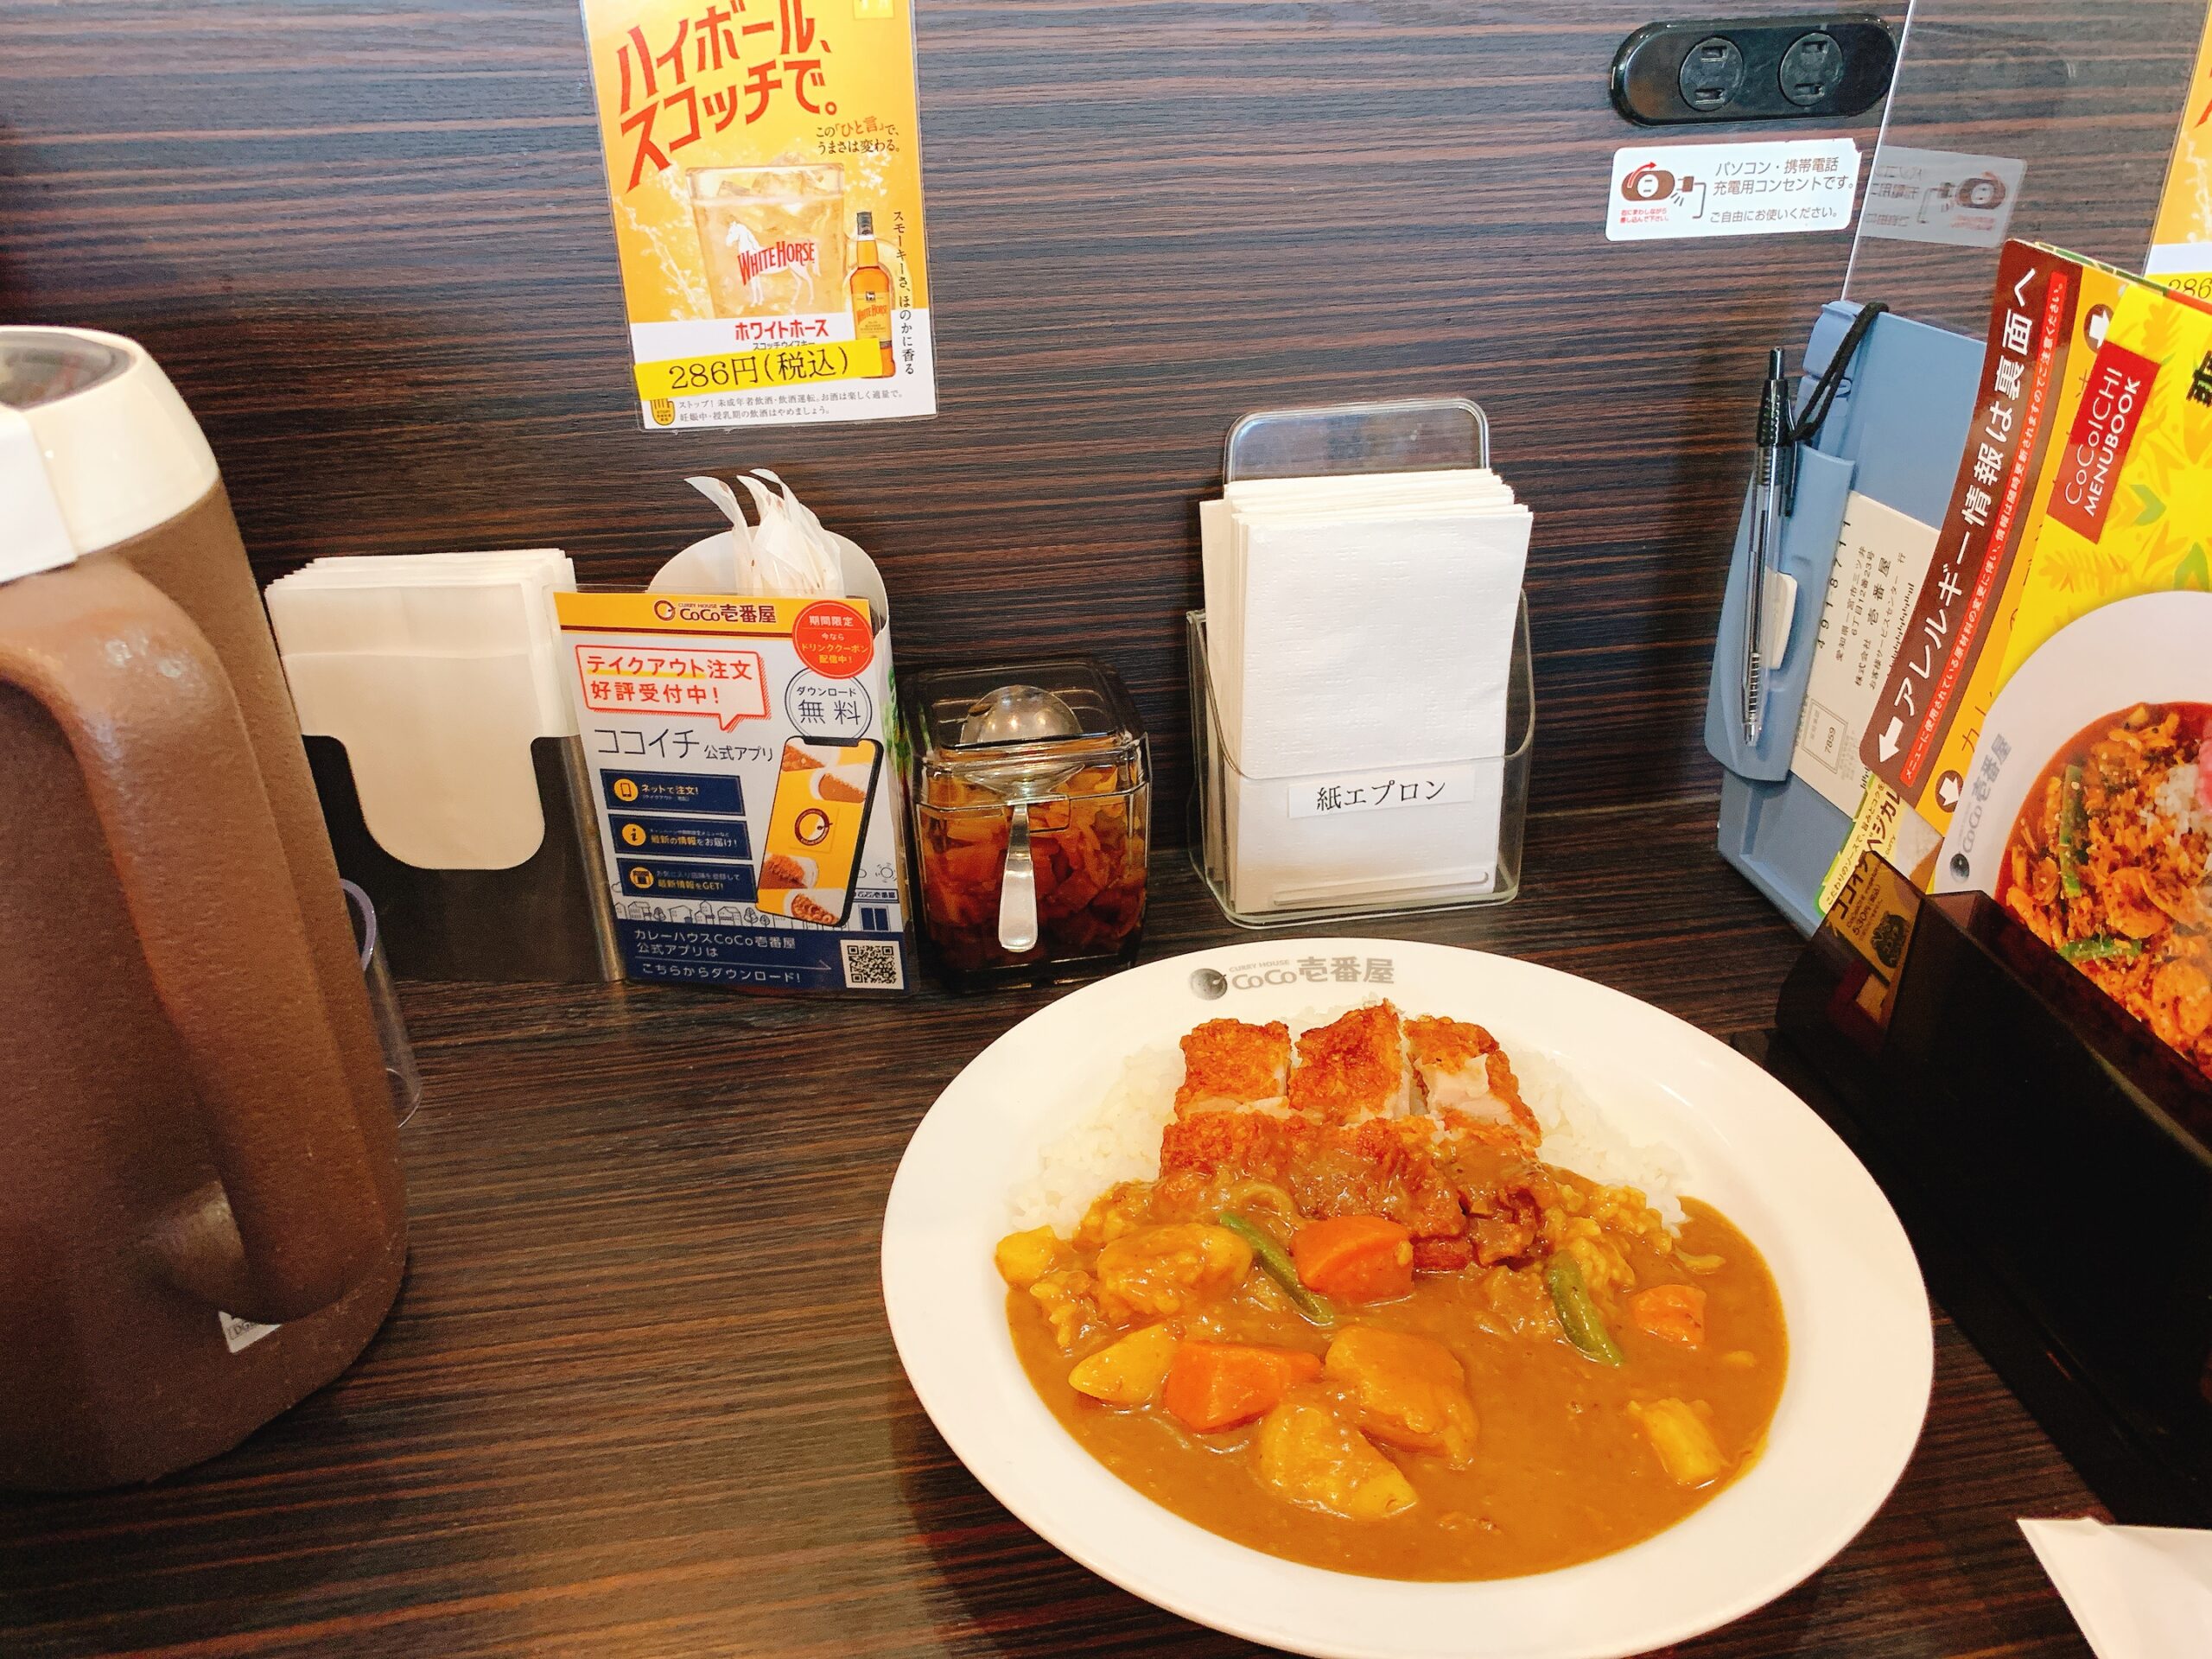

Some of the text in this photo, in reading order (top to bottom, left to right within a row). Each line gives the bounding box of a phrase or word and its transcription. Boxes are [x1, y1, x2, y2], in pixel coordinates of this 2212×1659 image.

[616, 0, 832, 117] ハイボール、
[620, 59, 838, 194] スコッチで。
[816, 116, 899, 138] この「ひと言」で、
[817, 138, 900, 155] うまさは変わる。
[1715, 156, 1839, 176] パソコン・携帯電話
[1713, 175, 1853, 196] 充電用コンセントです。
[1710, 206, 1838, 224] ご自由にお使いください。
[737, 240, 815, 286] WHITE HORSE
[893, 211, 914, 375] スモーキーさ、ほのかに香る
[735, 319, 830, 341] ホワイトホース
[668, 346, 849, 391] 286円(税込)
[2083, 378, 2141, 517] MENUBOOK
[1894, 268, 2037, 717] アレルギー情報は裏面へ
[1851, 550, 1876, 637] 6丁目12番23号
[680, 604, 776, 623] CoCo壱番屋
[809, 615, 854, 627] 期間限定
[1854, 557, 1892, 687] 株式会社 壱番屋
[1869, 552, 1907, 690] お客様サービスセンター 行
[802, 643, 869, 653] ドリンククーポン
[821, 632, 845, 641] 今なら
[587, 655, 753, 681] テイクアウト注文
[818, 654, 853, 664] 配信中!
[590, 680, 720, 705] 好評受付中!
[797, 686, 856, 697] ダウンロード
[798, 699, 861, 725] 無料
[594, 729, 774, 762] ココイチ 公式アプリ
[1824, 727, 1836, 754] 7859
[641, 783, 699, 795] ネットで注文!
[1316, 779, 1446, 811] 紙エプロン
[1962, 733, 2012, 854] CoCo壱番屋
[634, 928, 796, 949] カレーハウスCoCo壱番屋
[637, 942, 718, 957] 公式アプリは
[642, 963, 801, 983] こちらからダウンロード!
[1229, 959, 1290, 973] CURRY HOUSE
[1231, 956, 1395, 991] CoCo壱番屋
